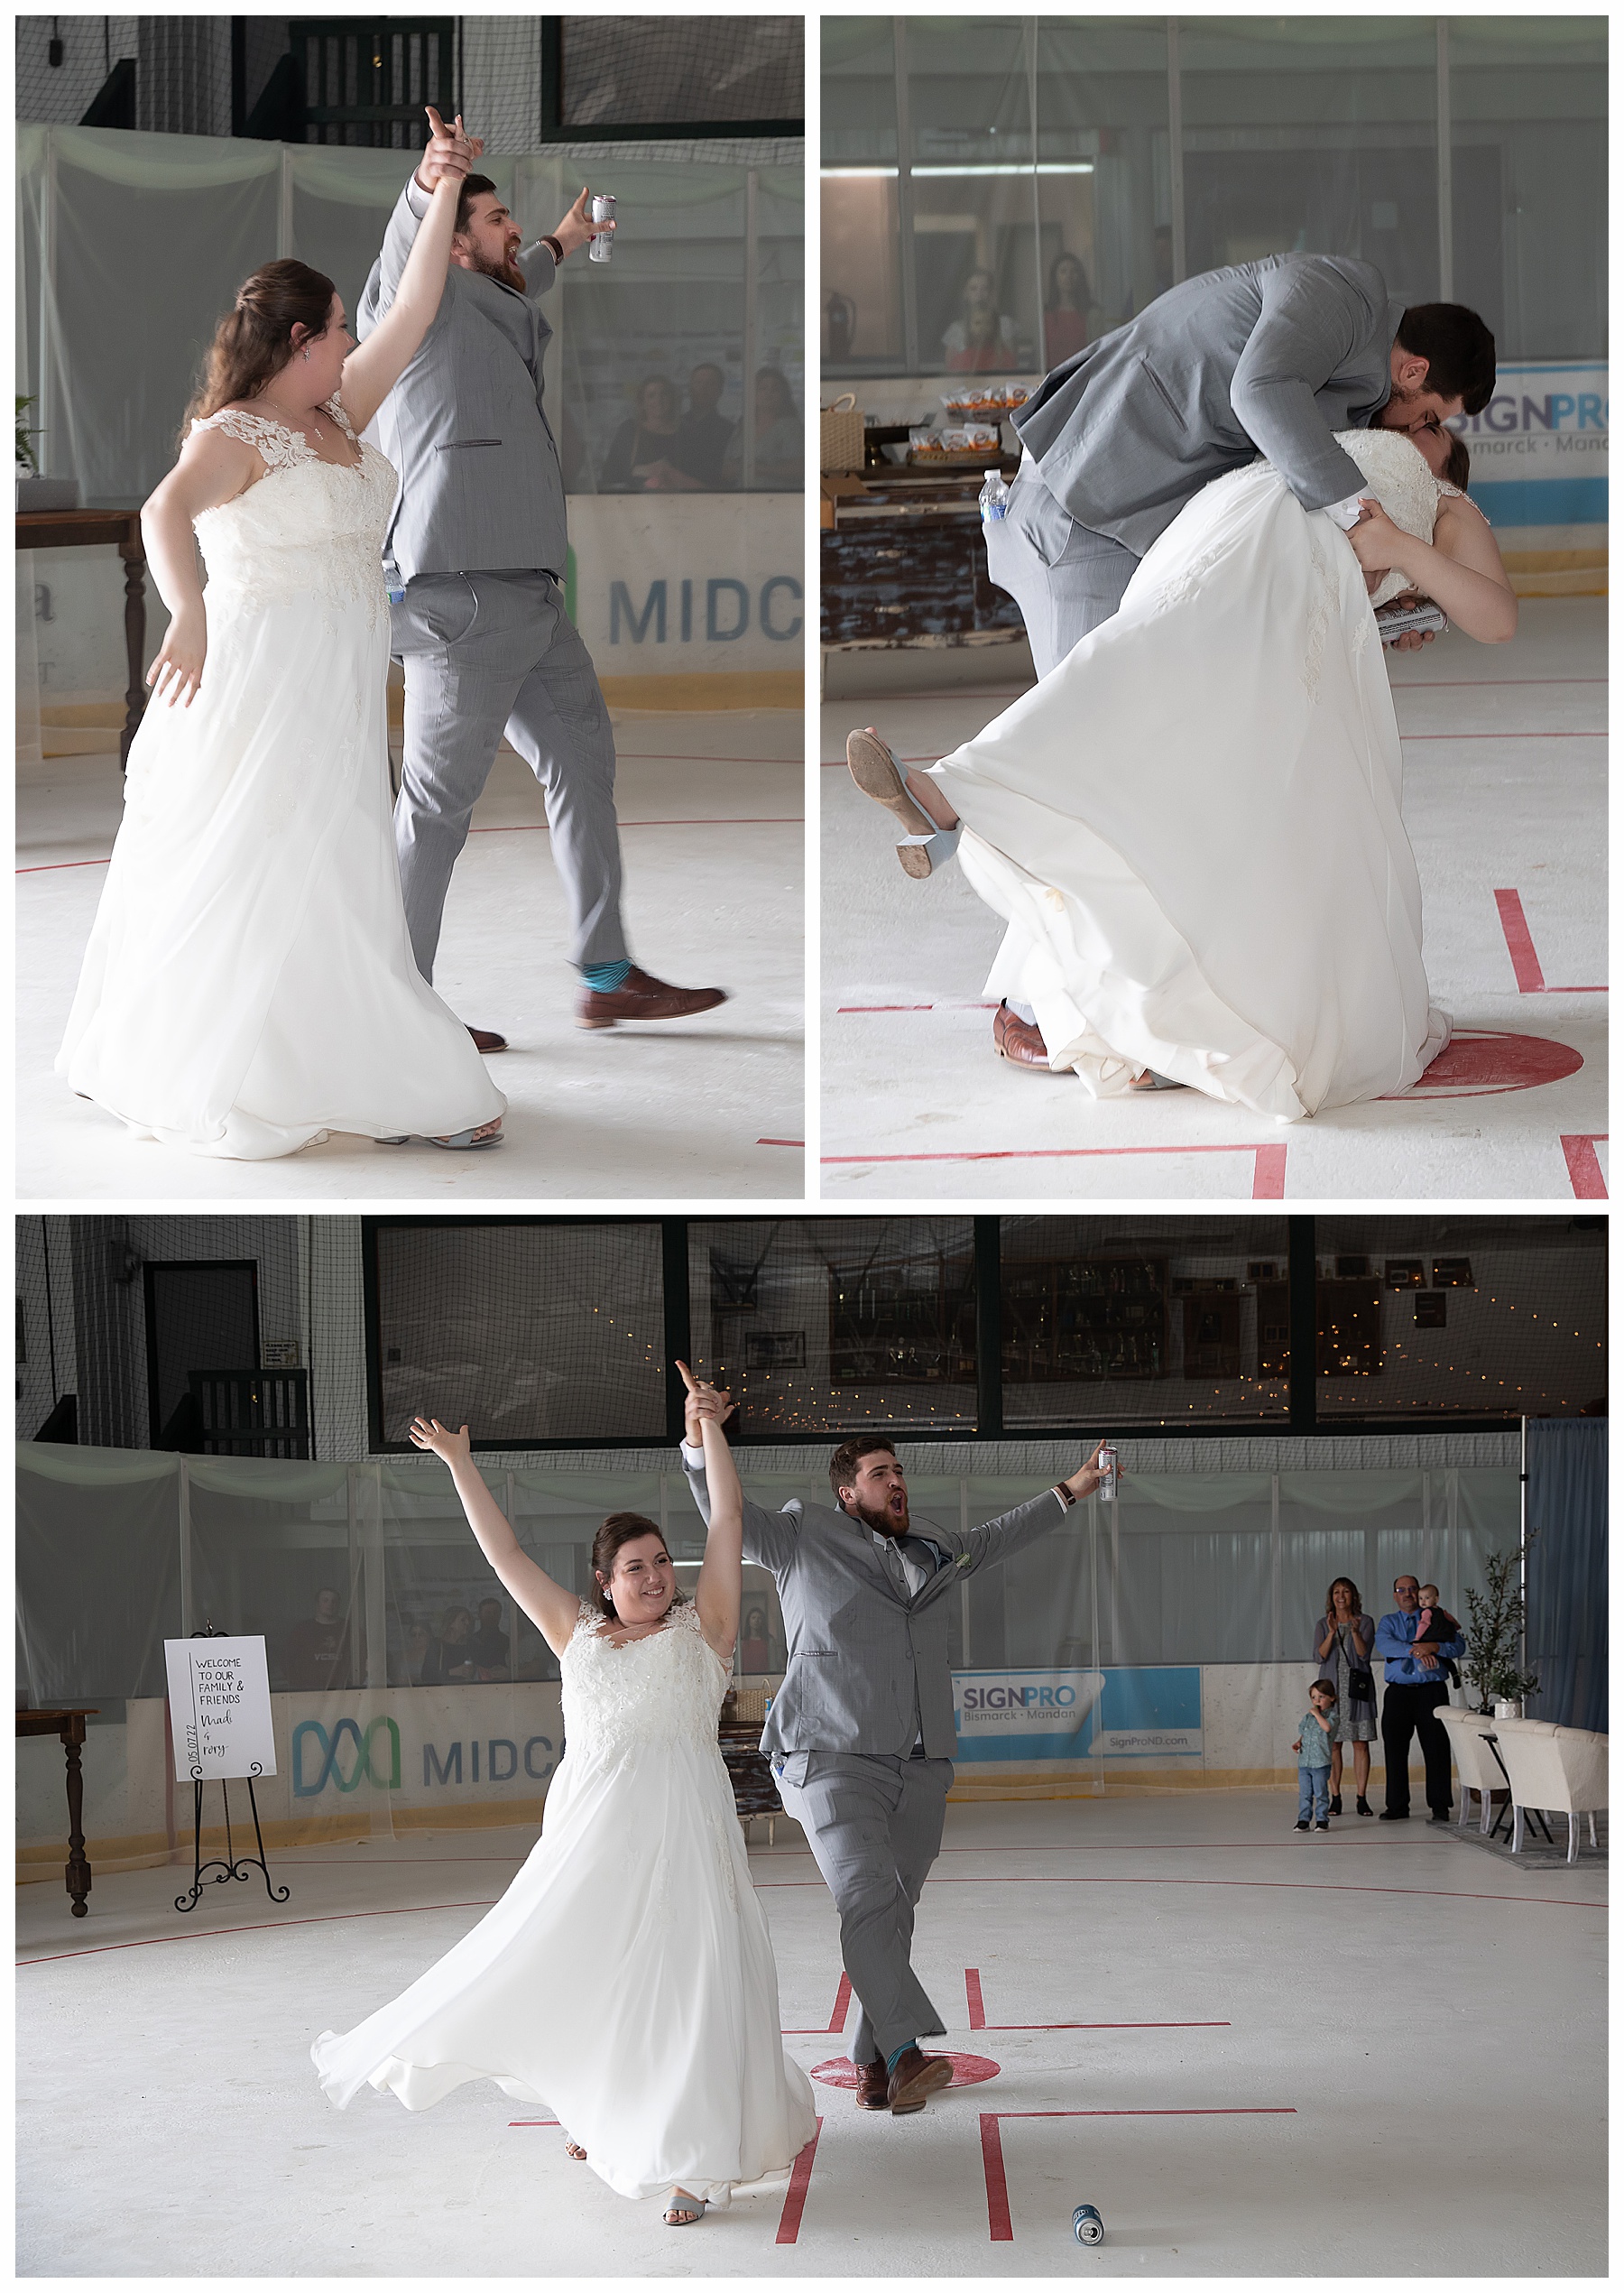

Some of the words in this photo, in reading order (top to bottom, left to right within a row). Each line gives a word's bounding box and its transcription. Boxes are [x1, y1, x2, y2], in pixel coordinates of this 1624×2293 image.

[195, 1659, 242, 1668] WELCOME
[198, 1671, 213, 1680] TO
[215, 1671, 235, 1680] OUR
[198, 1682, 233, 1692] FAMILY
[236, 1680, 245, 1691] &
[200, 1695, 240, 1705] FRIENDS
[964, 1685, 1076, 1709] SIGNPRO
[964, 1709, 1017, 1722] Bismarck
[1027, 1709, 1076, 1720] Mandan
[1110, 1735, 1187, 1749] SignProND.com
[423, 1735, 566, 1787] MIDC
